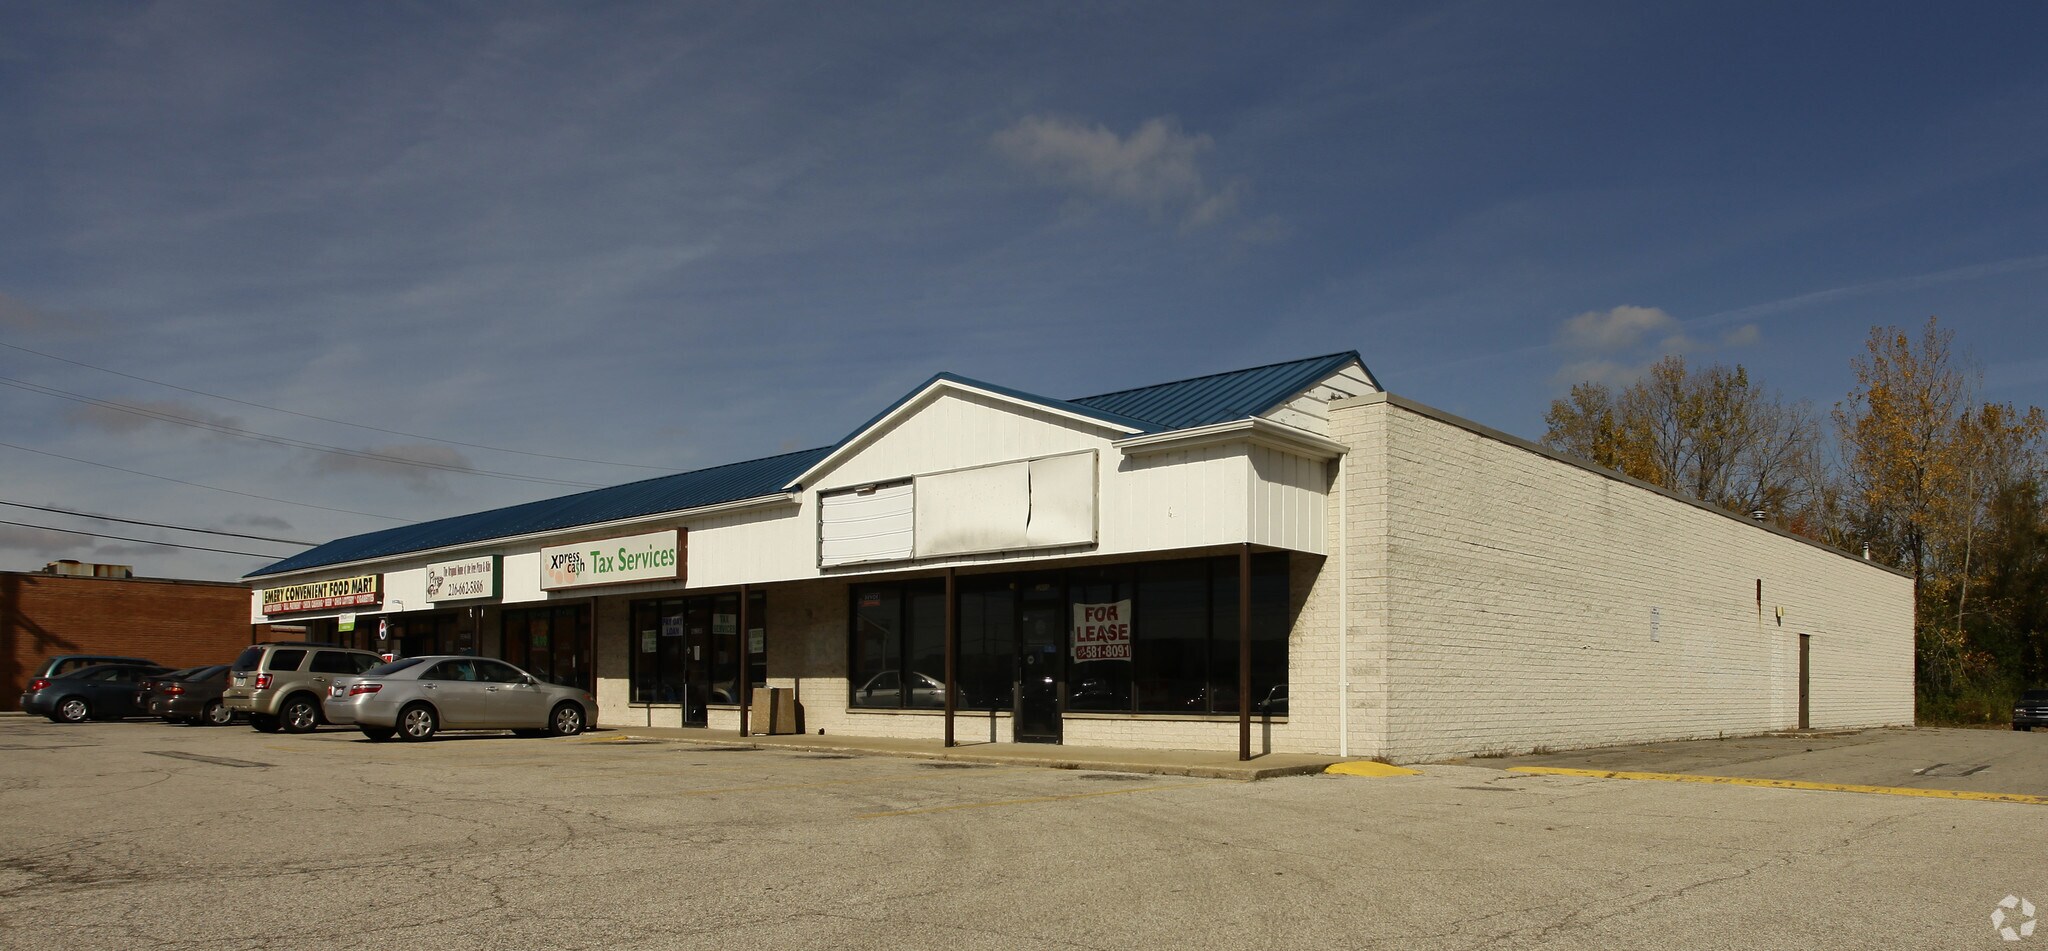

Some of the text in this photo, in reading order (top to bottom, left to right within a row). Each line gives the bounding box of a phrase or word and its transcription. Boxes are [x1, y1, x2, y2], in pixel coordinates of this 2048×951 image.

[590, 544, 675, 574] Tax Services
[265, 577, 373, 604] EMERY CONVENIENT FOOD MART
[1085, 606, 1118, 622] FOR
[1077, 624, 1129, 642] LEASE
